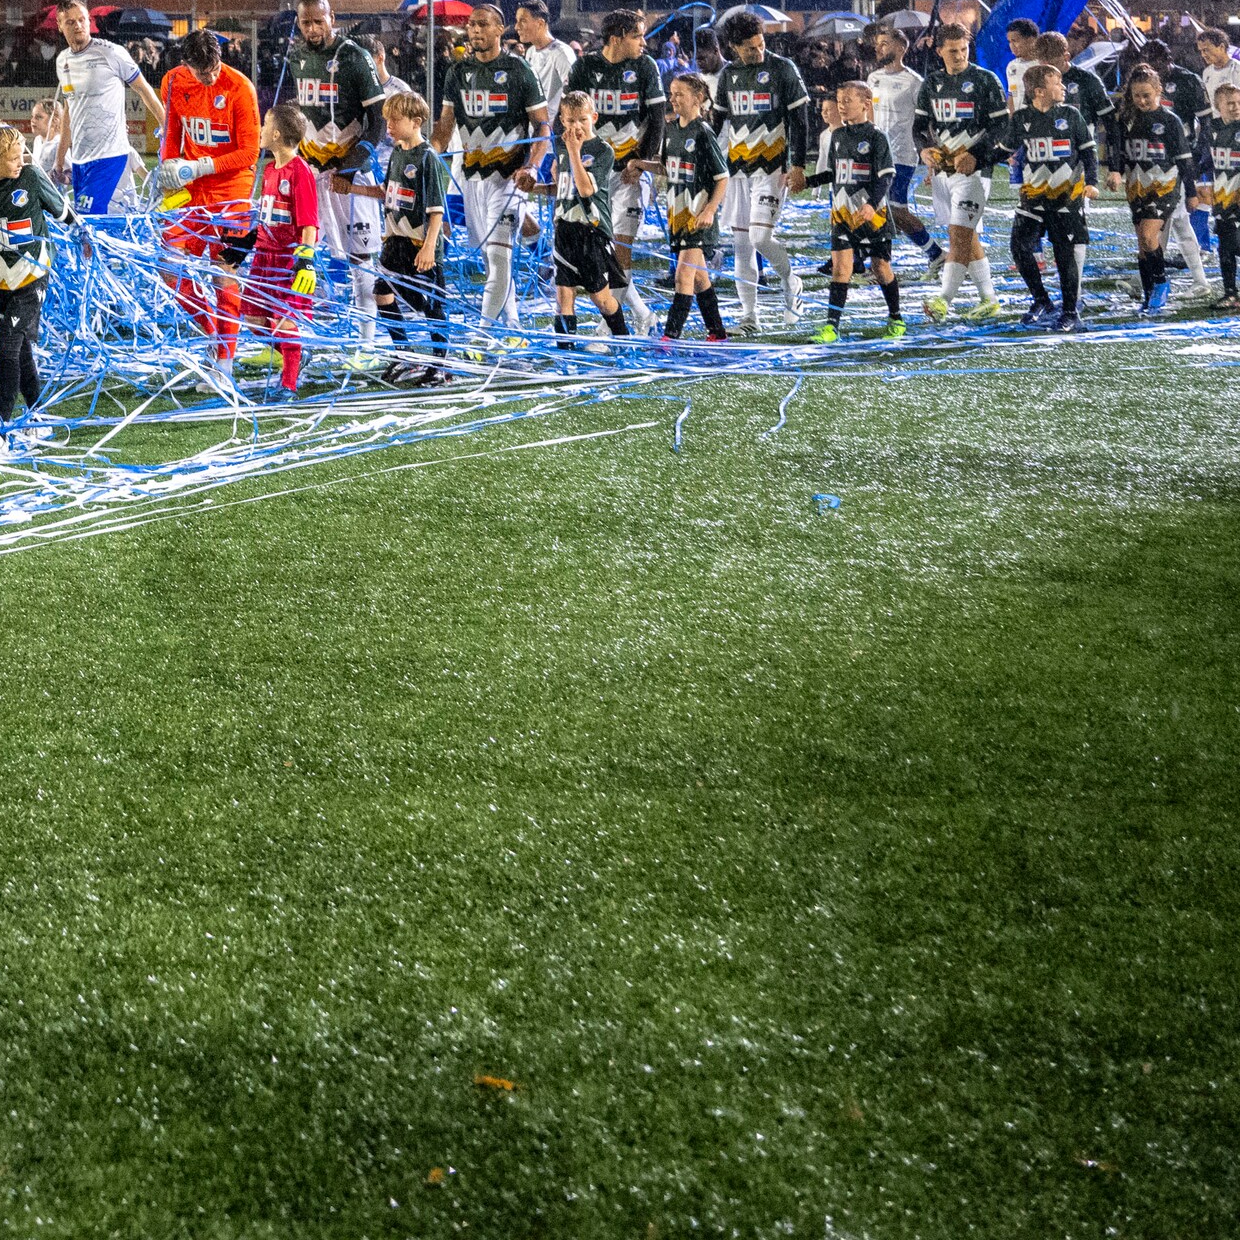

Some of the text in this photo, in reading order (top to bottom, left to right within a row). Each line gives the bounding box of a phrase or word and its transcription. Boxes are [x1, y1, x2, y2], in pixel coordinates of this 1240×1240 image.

[296, 77, 326, 107] VDL
[460, 89, 496, 117] VDL
[589, 88, 627, 116] VDL
[727, 90, 760, 116] VDL
[931, 98, 962, 122] VDL
[181, 115, 218, 148] VDL
[1023, 136, 1060, 162] VDL
[1125, 138, 1153, 161] VDL
[1210, 146, 1236, 170] VDL
[385, 180, 402, 211] DL
[556, 171, 575, 200] DL
[259, 194, 280, 227] DL
